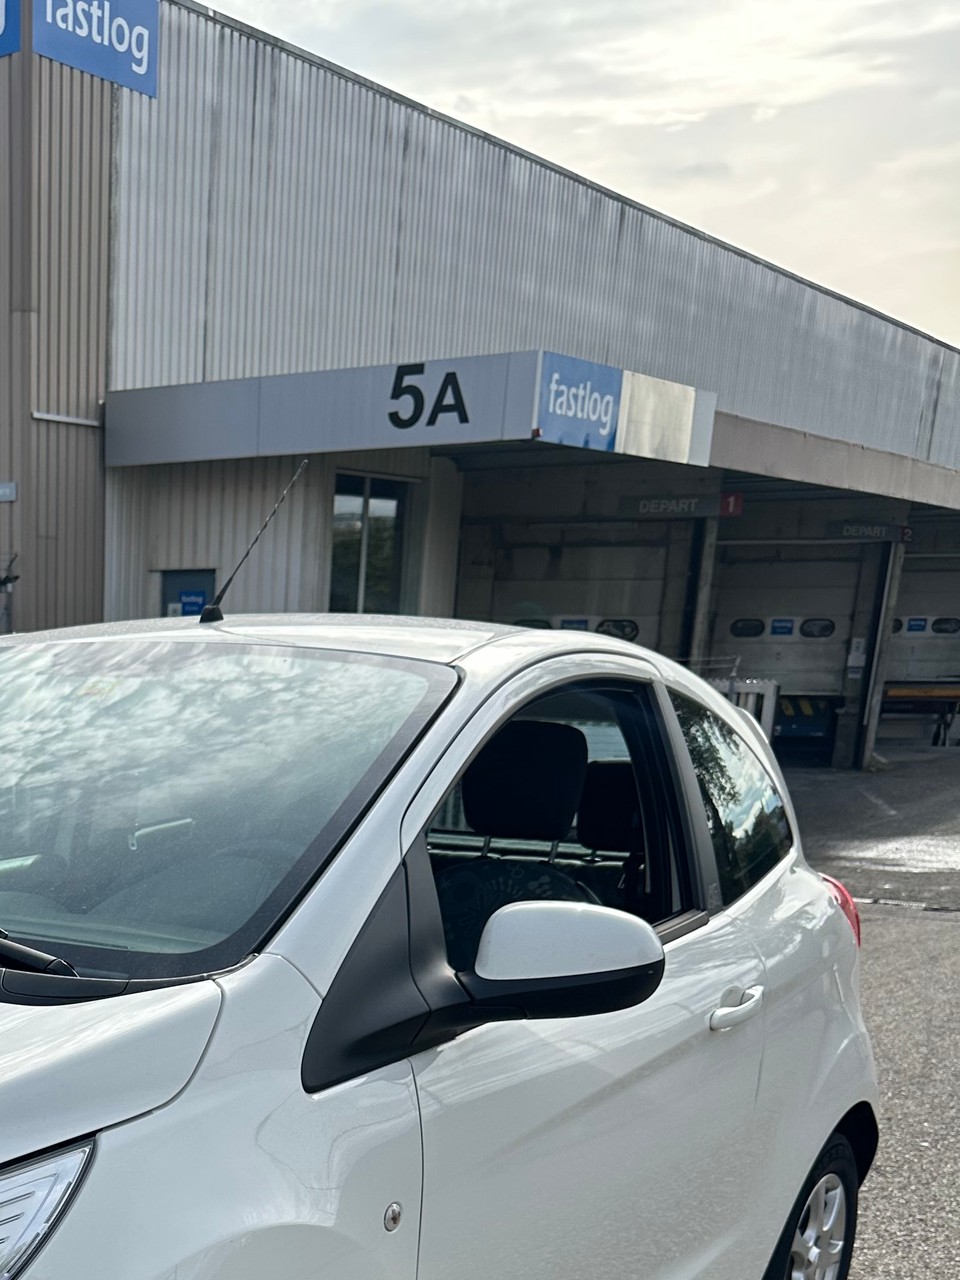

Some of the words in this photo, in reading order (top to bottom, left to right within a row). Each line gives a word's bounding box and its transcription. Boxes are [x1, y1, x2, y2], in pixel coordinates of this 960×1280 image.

[388, 363, 469, 429] 5A
[548, 372, 614, 436] fastlog
[727, 496, 736, 513] 1
[903, 528, 913, 541] 2
